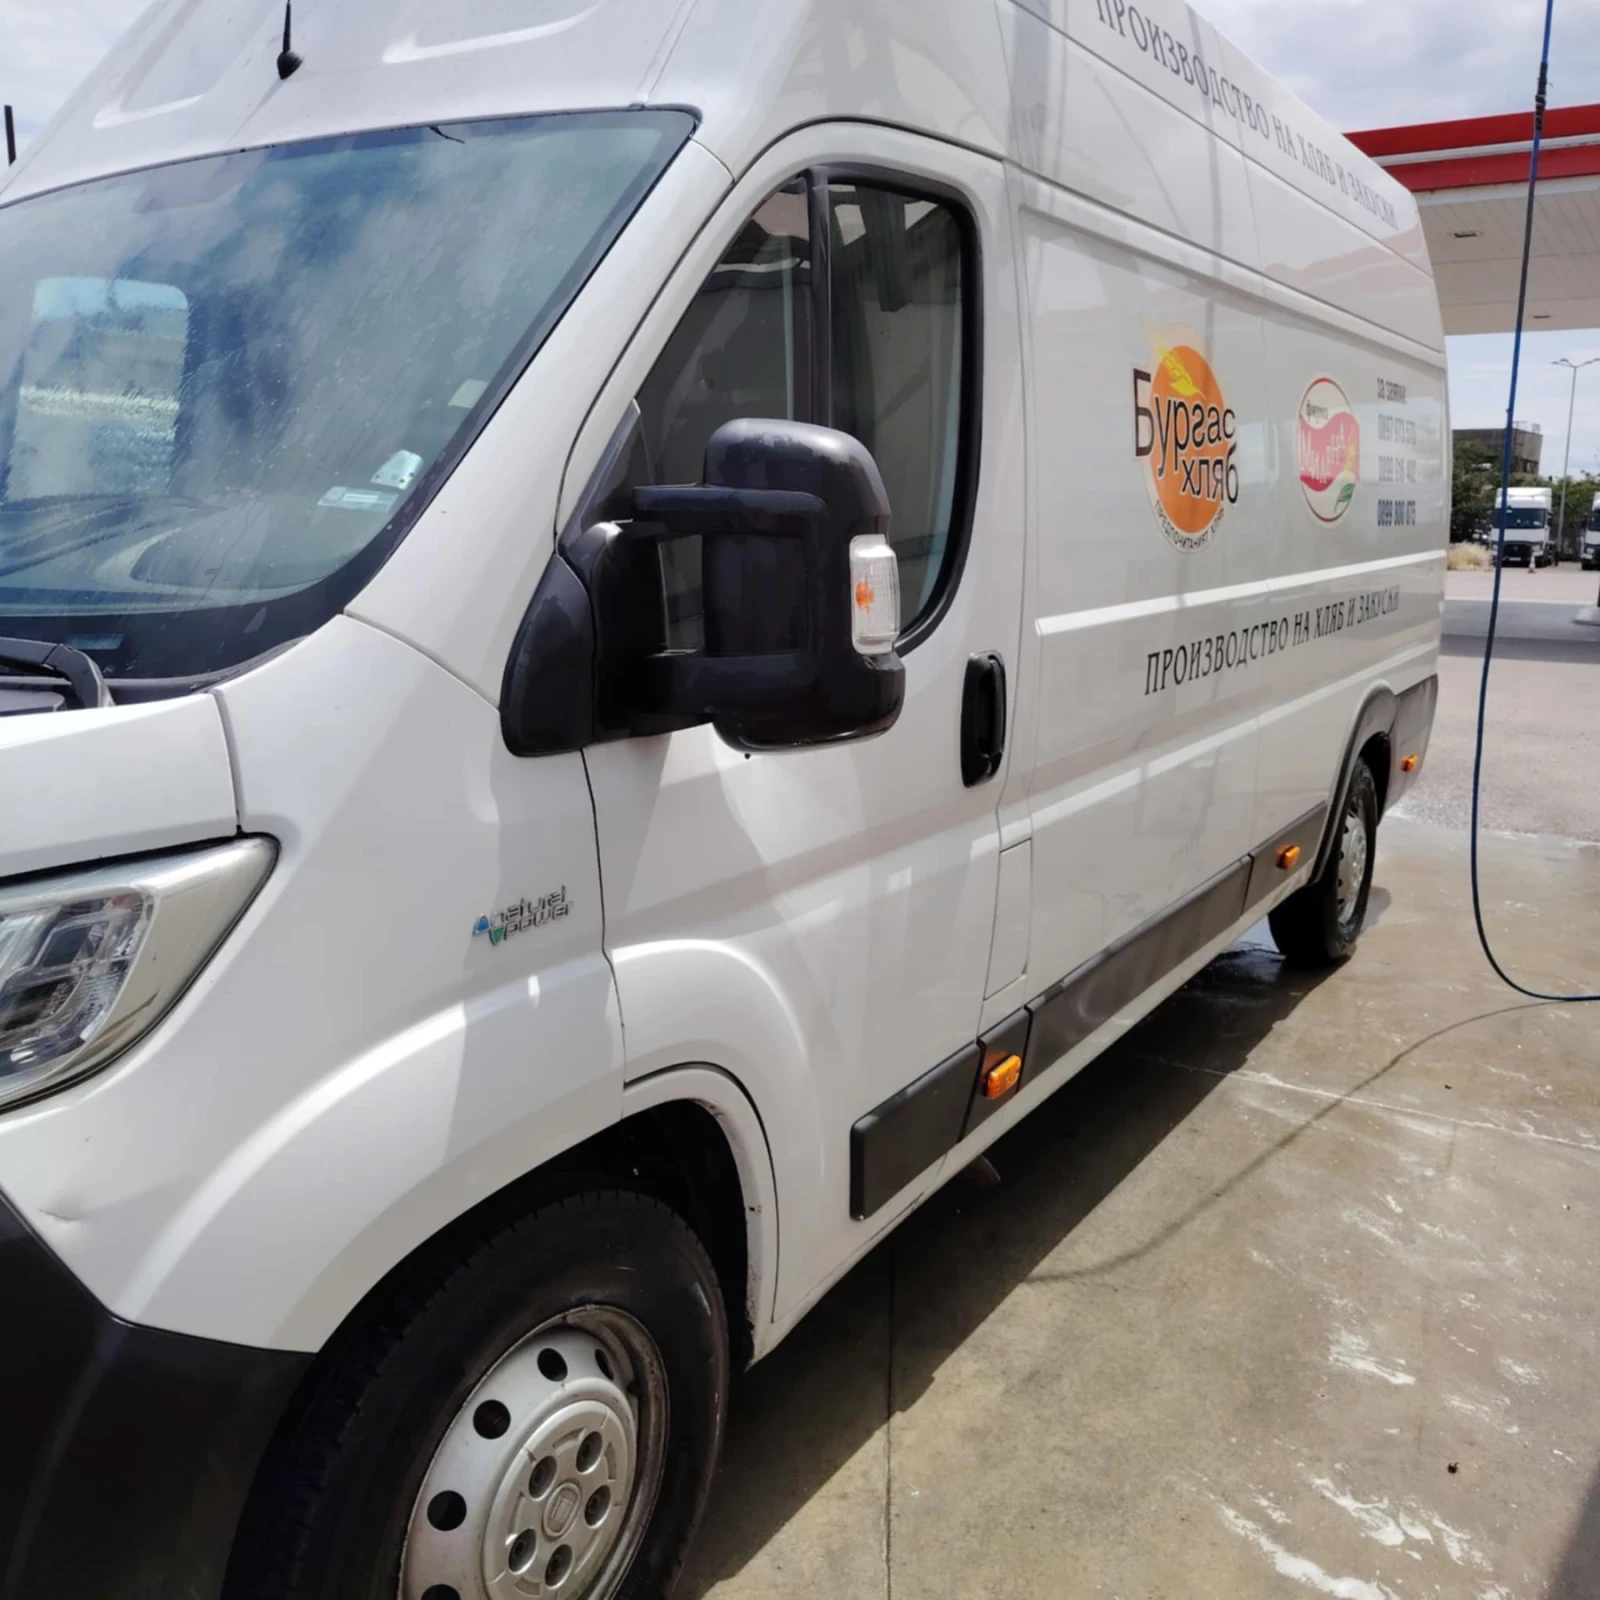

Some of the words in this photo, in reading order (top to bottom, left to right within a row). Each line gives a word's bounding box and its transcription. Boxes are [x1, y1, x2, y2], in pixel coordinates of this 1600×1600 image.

[1096, 0, 1269, 140] ПРОИЗВОДСТВО
[1272, 115, 1298, 161] НА
[1297, 133, 1336, 186] ХЛЯБ
[1335, 162, 1349, 196] И
[1133, 368, 1236, 477] Бургас
[1182, 442, 1239, 504] хляб
[1144, 617, 1288, 696] ПРОИЗВОДСТВО
[1292, 611, 1310, 647] НА
[1313, 601, 1344, 640] ХЛЯБ
[1346, 598, 1356, 628] И
[1357, 585, 1400, 624] ЗАКУСКИ
